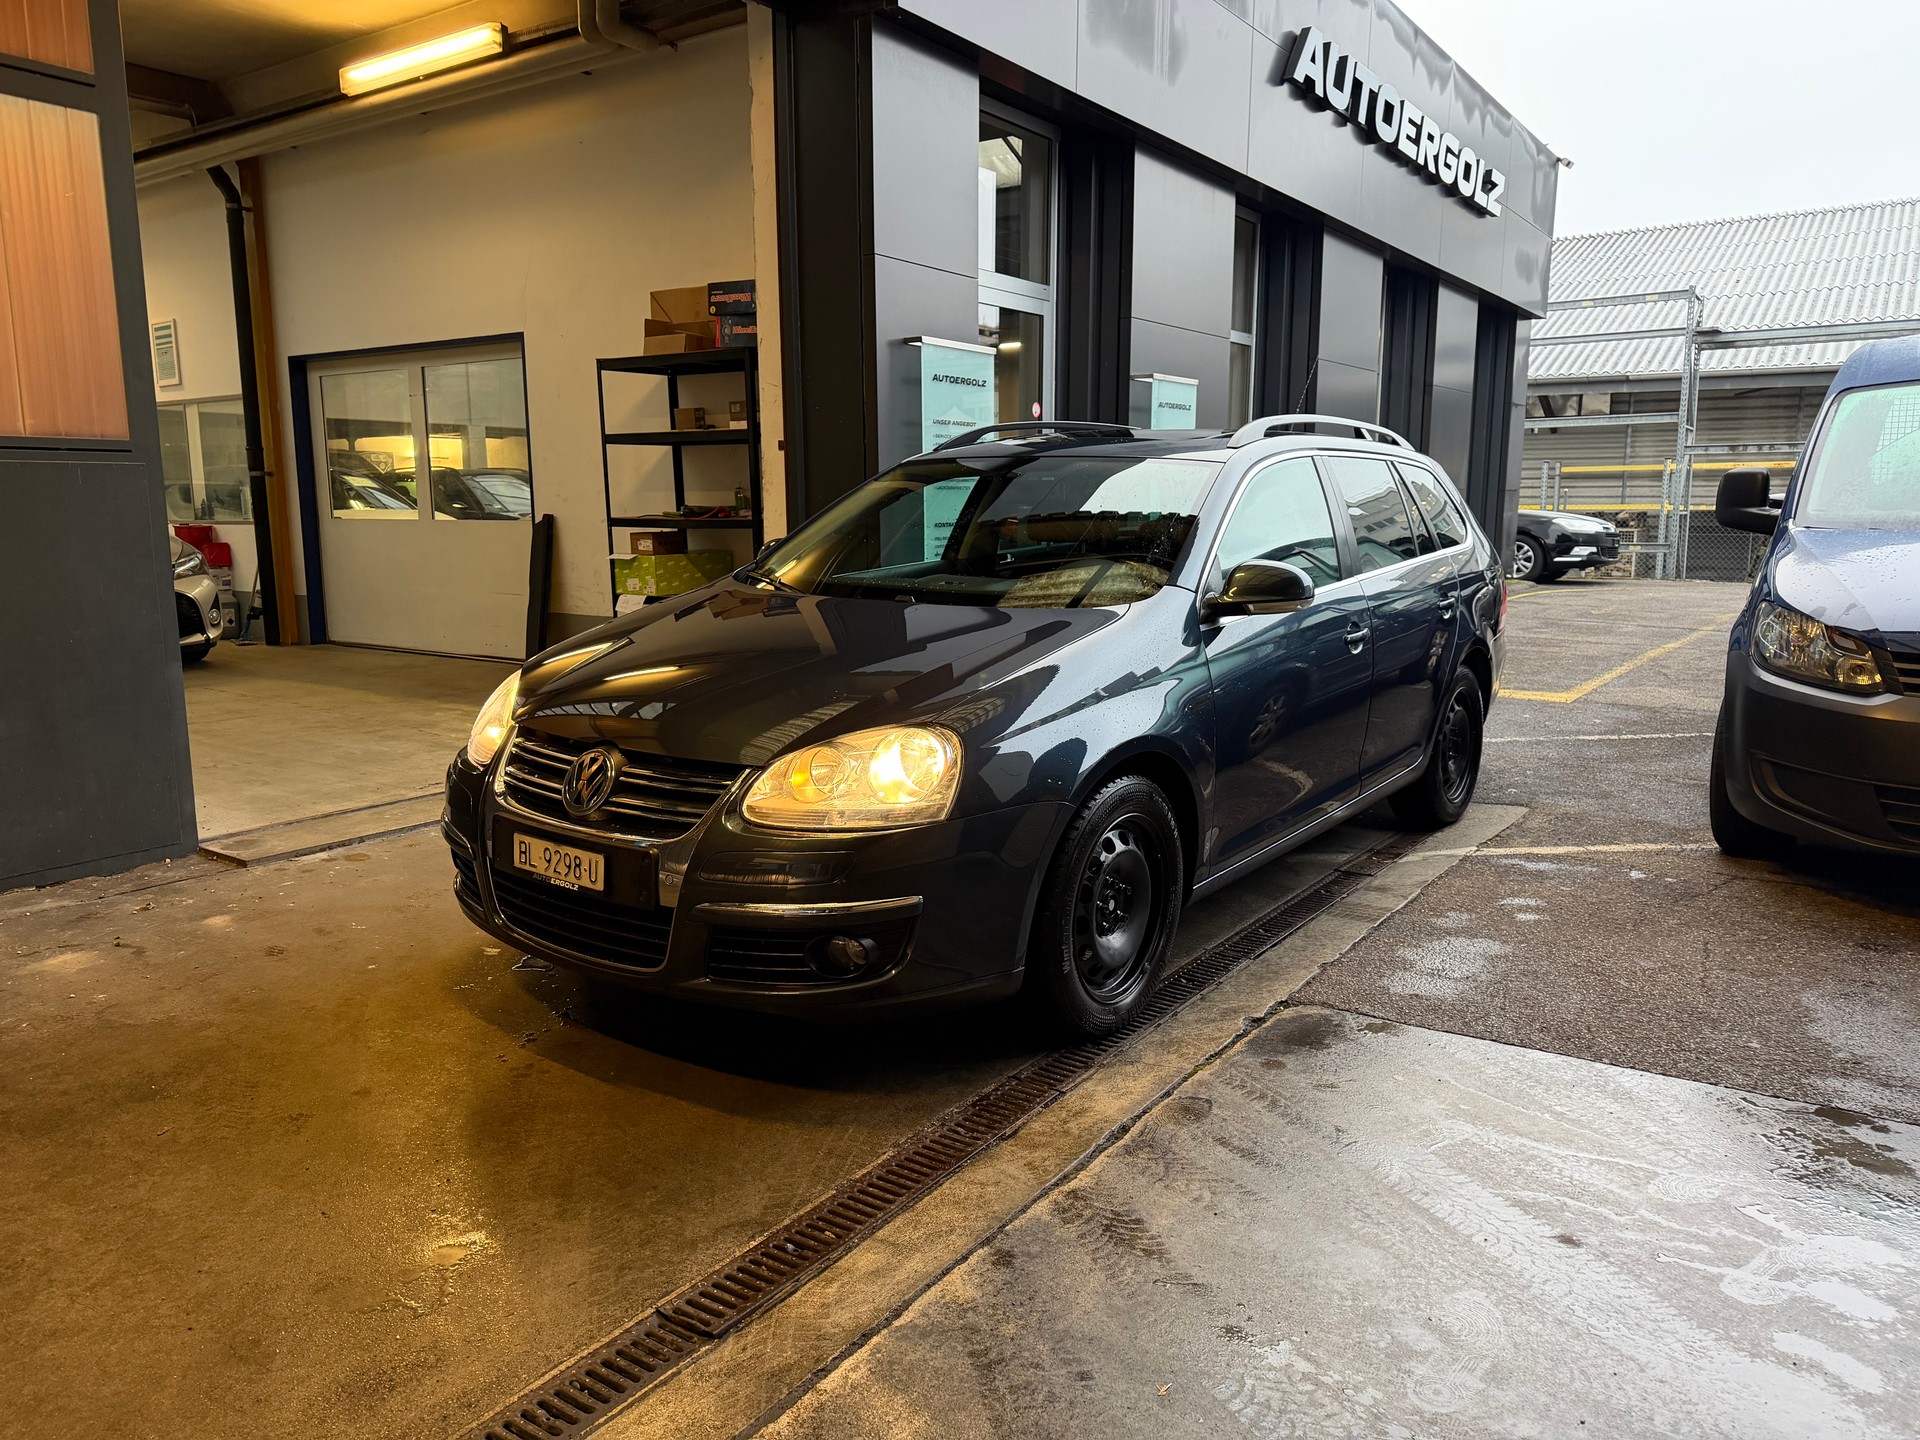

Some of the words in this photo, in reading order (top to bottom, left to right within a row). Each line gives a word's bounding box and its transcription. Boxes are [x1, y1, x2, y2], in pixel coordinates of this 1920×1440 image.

[1291, 25, 1506, 218] AUTOERGOLZ
[932, 373, 987, 388] AUTOERGOLZ
[1158, 401, 1192, 411] AUTOERGOLZ
[519, 839, 538, 869] BL
[532, 872, 579, 891] AUTOERGOLZ
